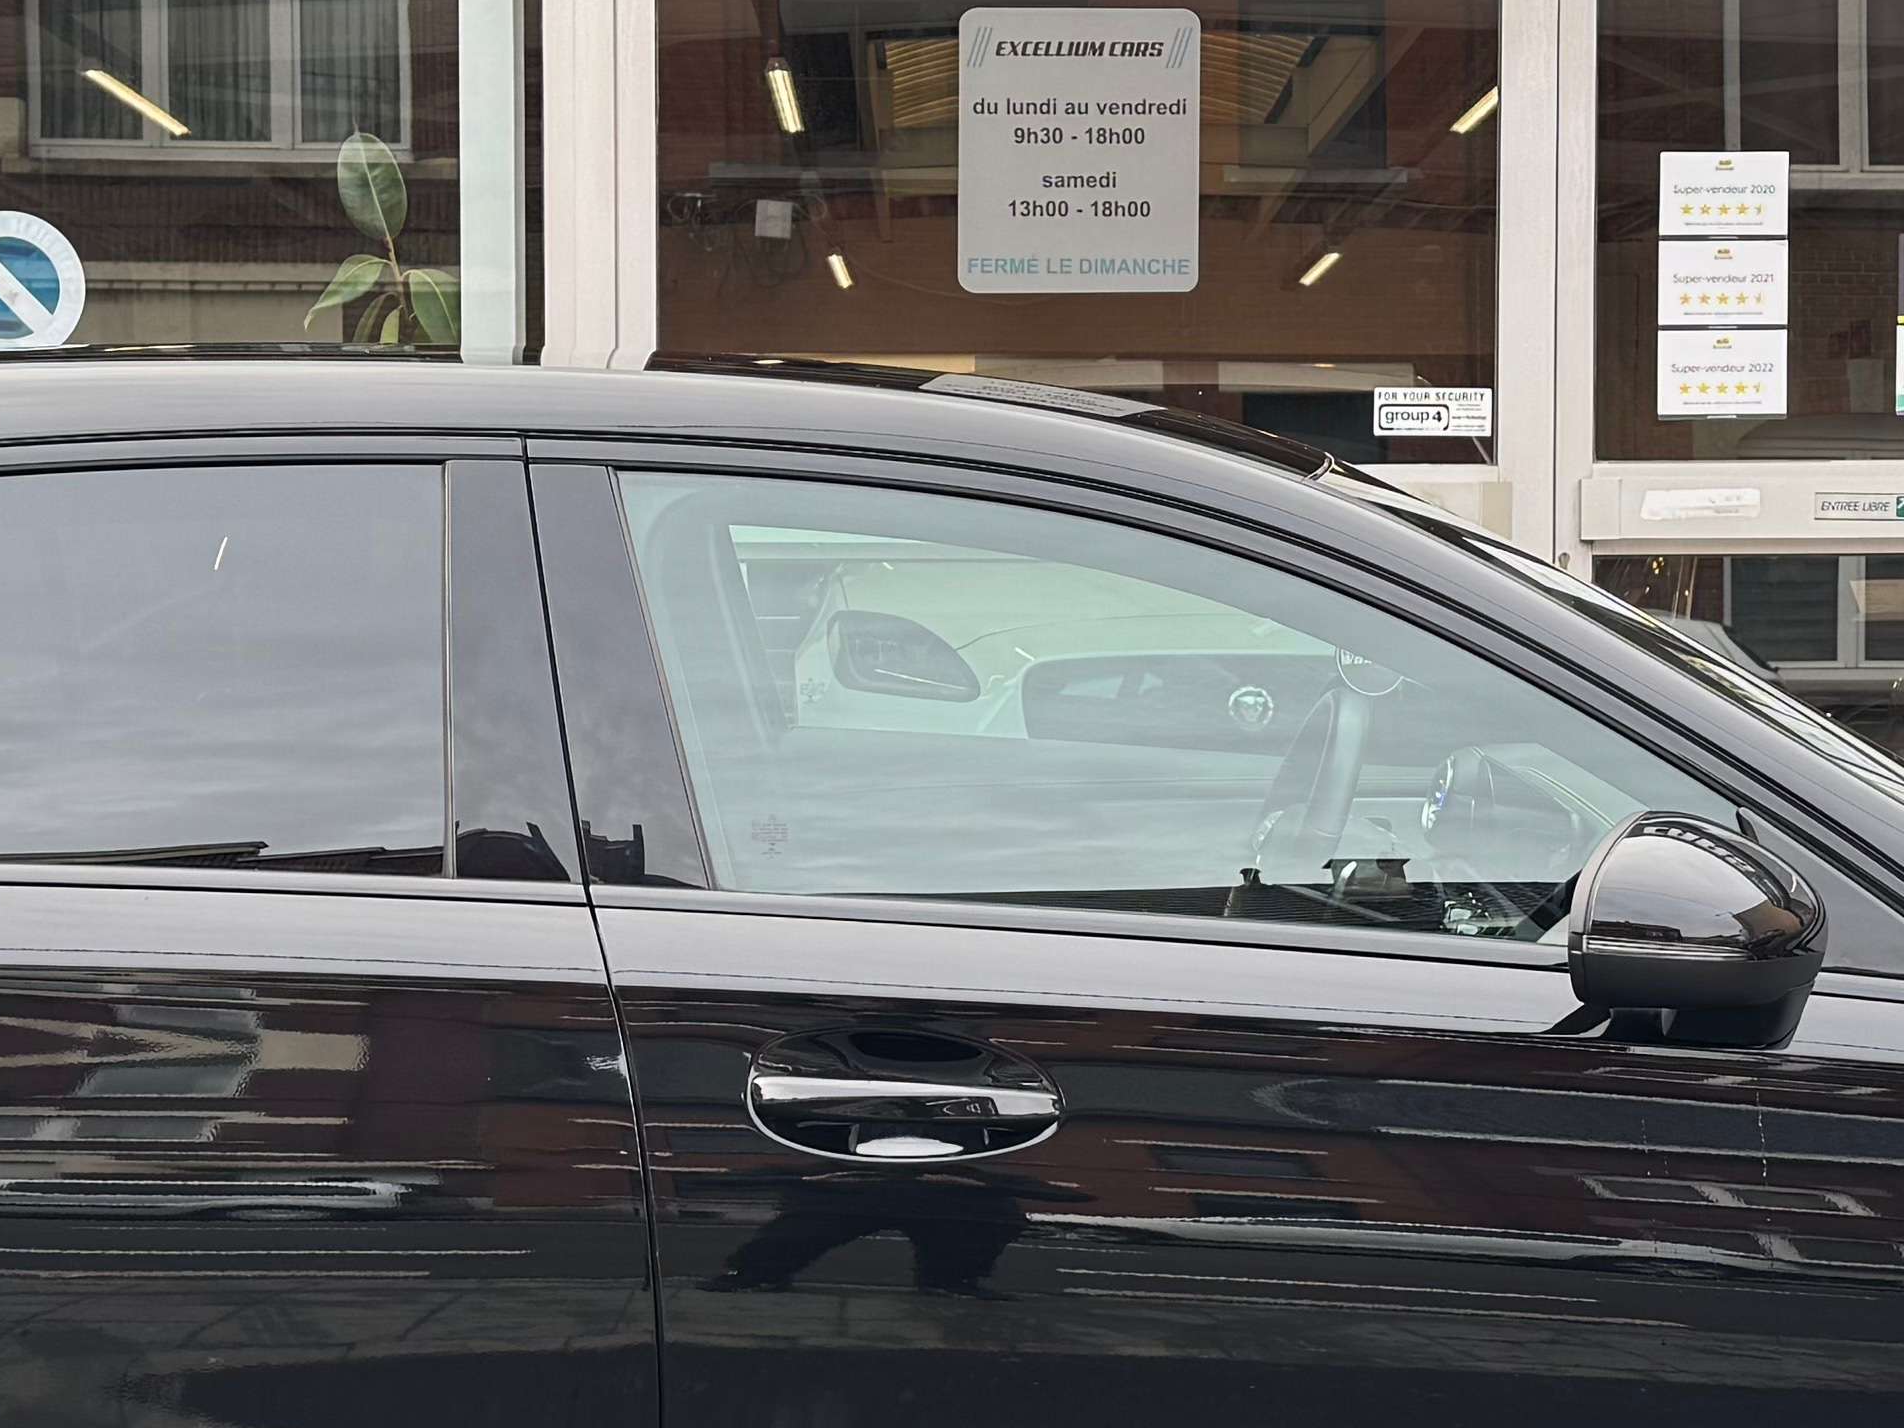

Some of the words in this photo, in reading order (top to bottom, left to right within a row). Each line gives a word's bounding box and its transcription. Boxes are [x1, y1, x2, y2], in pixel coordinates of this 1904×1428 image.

[995, 40, 1105, 58] EXCELLIUM
[1108, 40, 1164, 58] CARS
[972, 97, 998, 116] du
[1005, 97, 1057, 116] lundi
[1064, 101, 1089, 116] au
[1095, 97, 1187, 116] vendredi
[1013, 127, 1064, 146] 9h30
[1085, 127, 1146, 146] 18h00
[1042, 171, 1117, 190] samedi
[1007, 200, 1069, 219] 13h00
[1090, 200, 1151, 219] 18h00
[1046, 257, 1073, 275] LE
[1079, 257, 1191, 276] DIMANCHE
[1750, 273, 1775, 283] 2021
[1748, 363, 1774, 373] 2022
[1378, 391, 1397, 401] FOR
[1403, 391, 1430, 401] YOUR
[1436, 391, 1485, 402] SECURITY
[1385, 411, 1430, 424] group
[1432, 410, 1442, 423] 4
[1862, 501, 1891, 512] LIBRE
